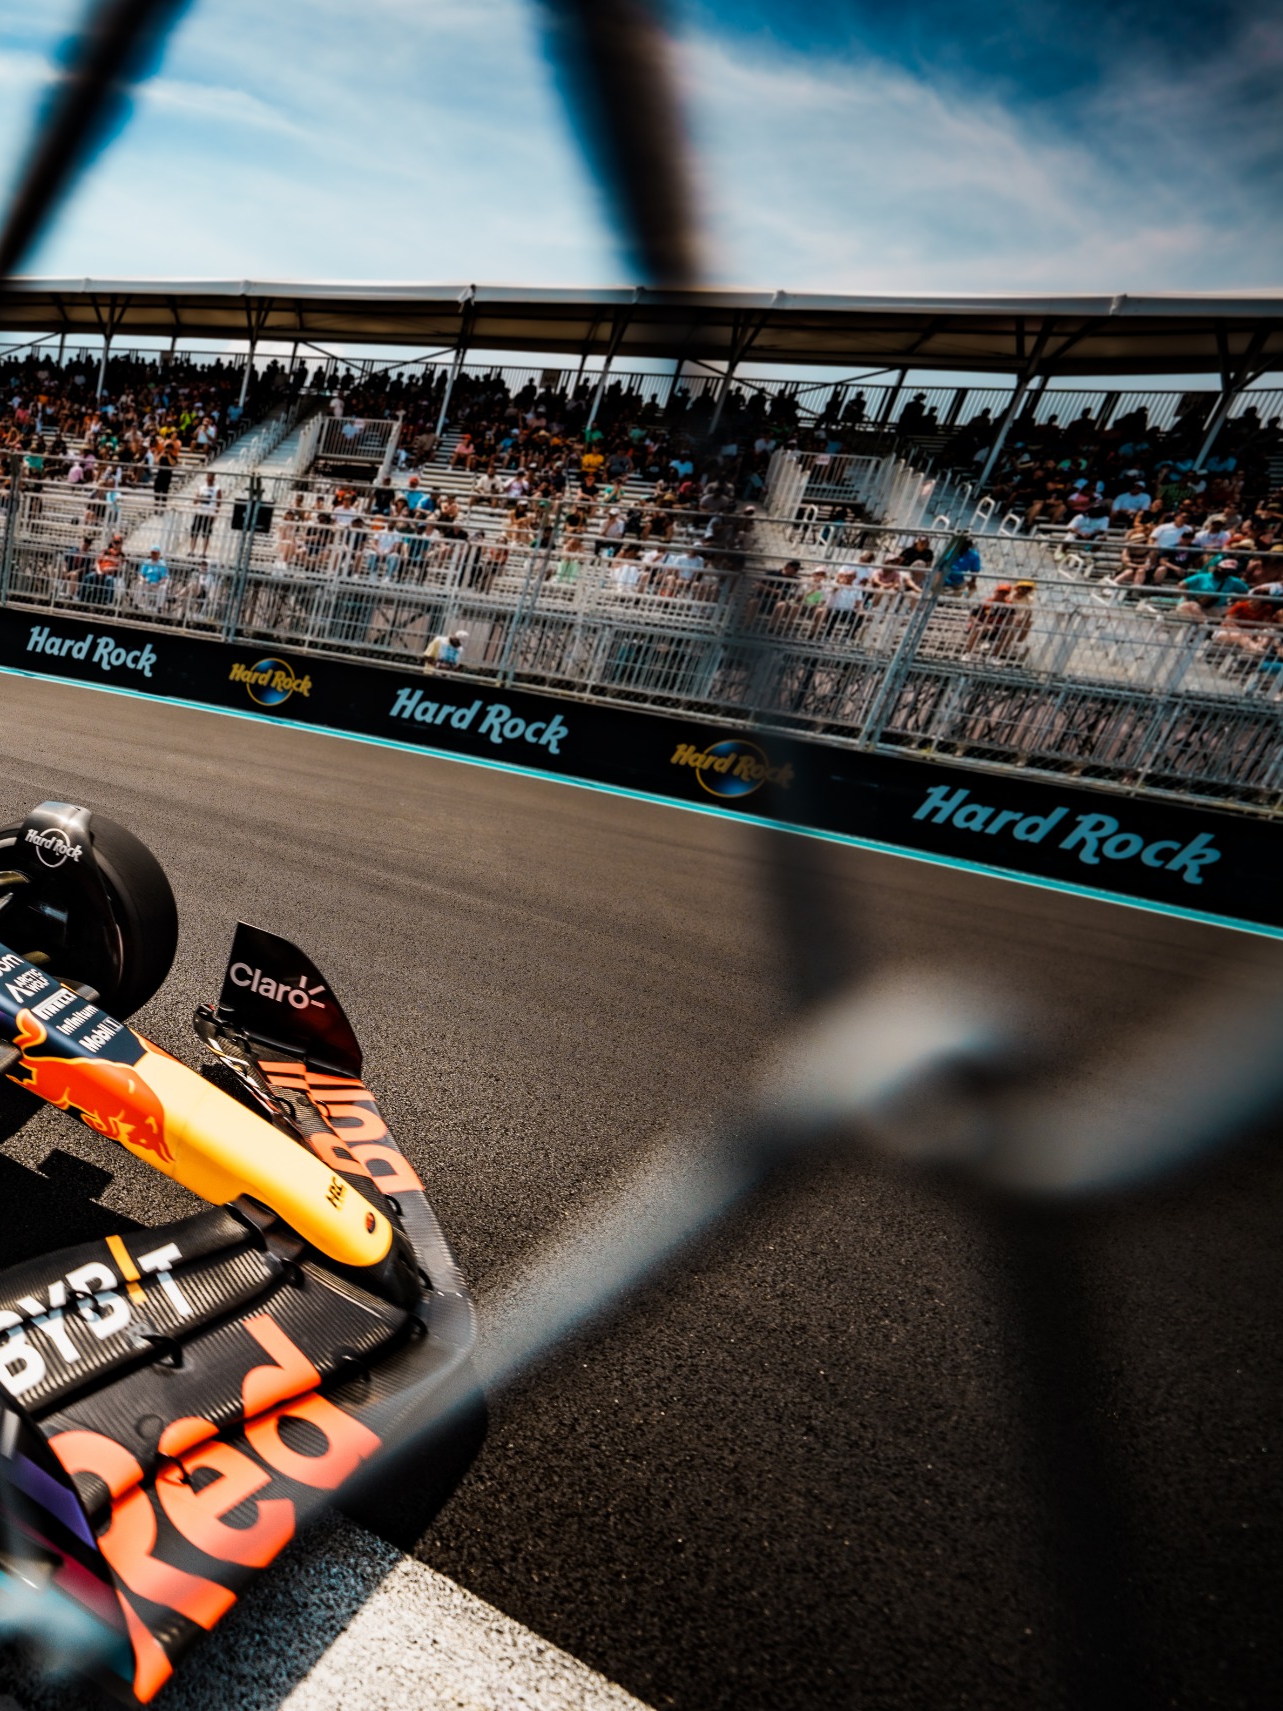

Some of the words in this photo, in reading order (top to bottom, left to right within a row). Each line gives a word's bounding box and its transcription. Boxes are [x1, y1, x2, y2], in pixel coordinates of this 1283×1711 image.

[26, 624, 94, 664] Hard
[92, 635, 158, 678] Rock
[228, 662, 271, 690] Hard
[268, 669, 313, 697] Rock
[389, 687, 482, 731] Hard
[476, 699, 569, 754] Rock
[669, 741, 733, 774] Hard
[729, 753, 796, 789] Rock
[24, 829, 57, 850] Hard
[52, 839, 83, 862] Rock
[912, 784, 1069, 844] Hard
[1058, 812, 1221, 885] Rock
[17, 968, 45, 987] ARCTIC
[25, 976, 52, 997] WOLF
[229, 962, 310, 1010] Claro
[30, 987, 79, 1021] PIRELLI
[78, 1021, 116, 1054] Mobil
[47, 1312, 383, 1704] Red
